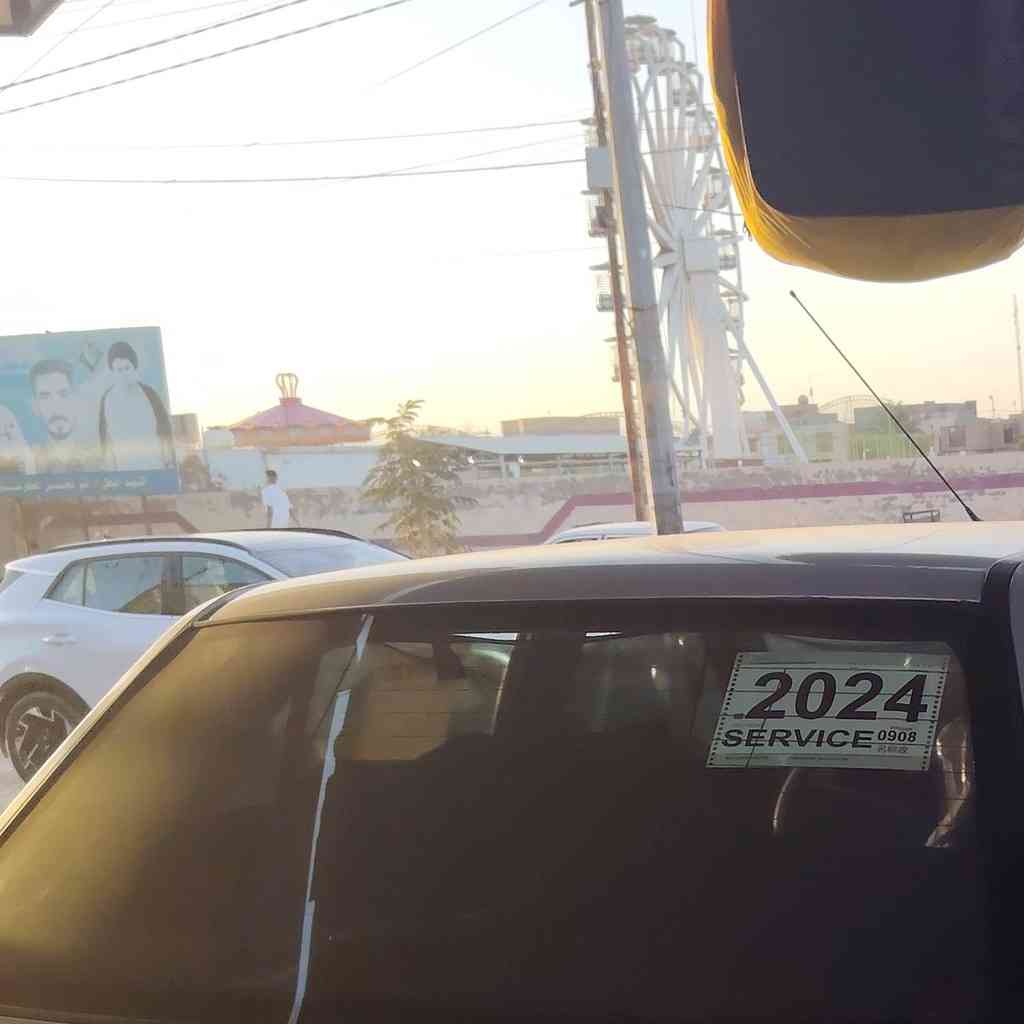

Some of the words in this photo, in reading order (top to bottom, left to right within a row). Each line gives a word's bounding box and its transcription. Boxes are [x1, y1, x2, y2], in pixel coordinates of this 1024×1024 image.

[745, 671, 928, 722] 2024
[722, 728, 874, 748] SERVICE
[878, 730, 917, 743] 0908
